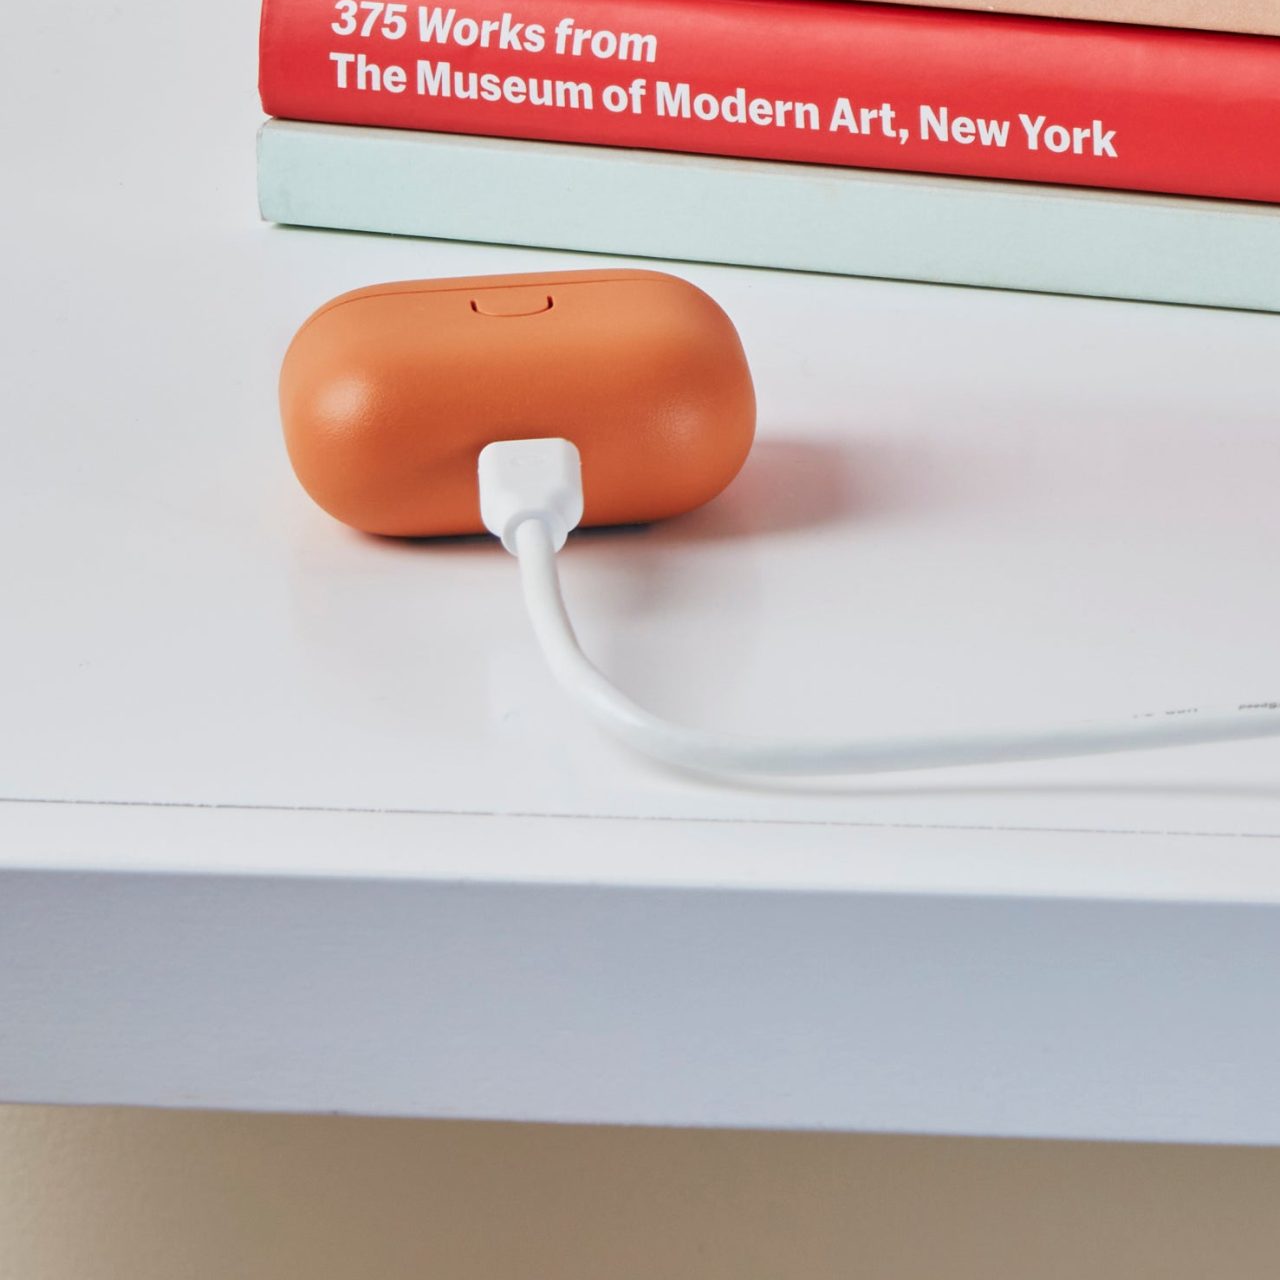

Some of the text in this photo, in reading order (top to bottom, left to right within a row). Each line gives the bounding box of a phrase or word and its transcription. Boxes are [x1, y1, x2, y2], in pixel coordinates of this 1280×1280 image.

[417, 5, 546, 53] Works
[554, 16, 658, 62] from
[329, 51, 1118, 158] The Museum of Modern Art, New York
